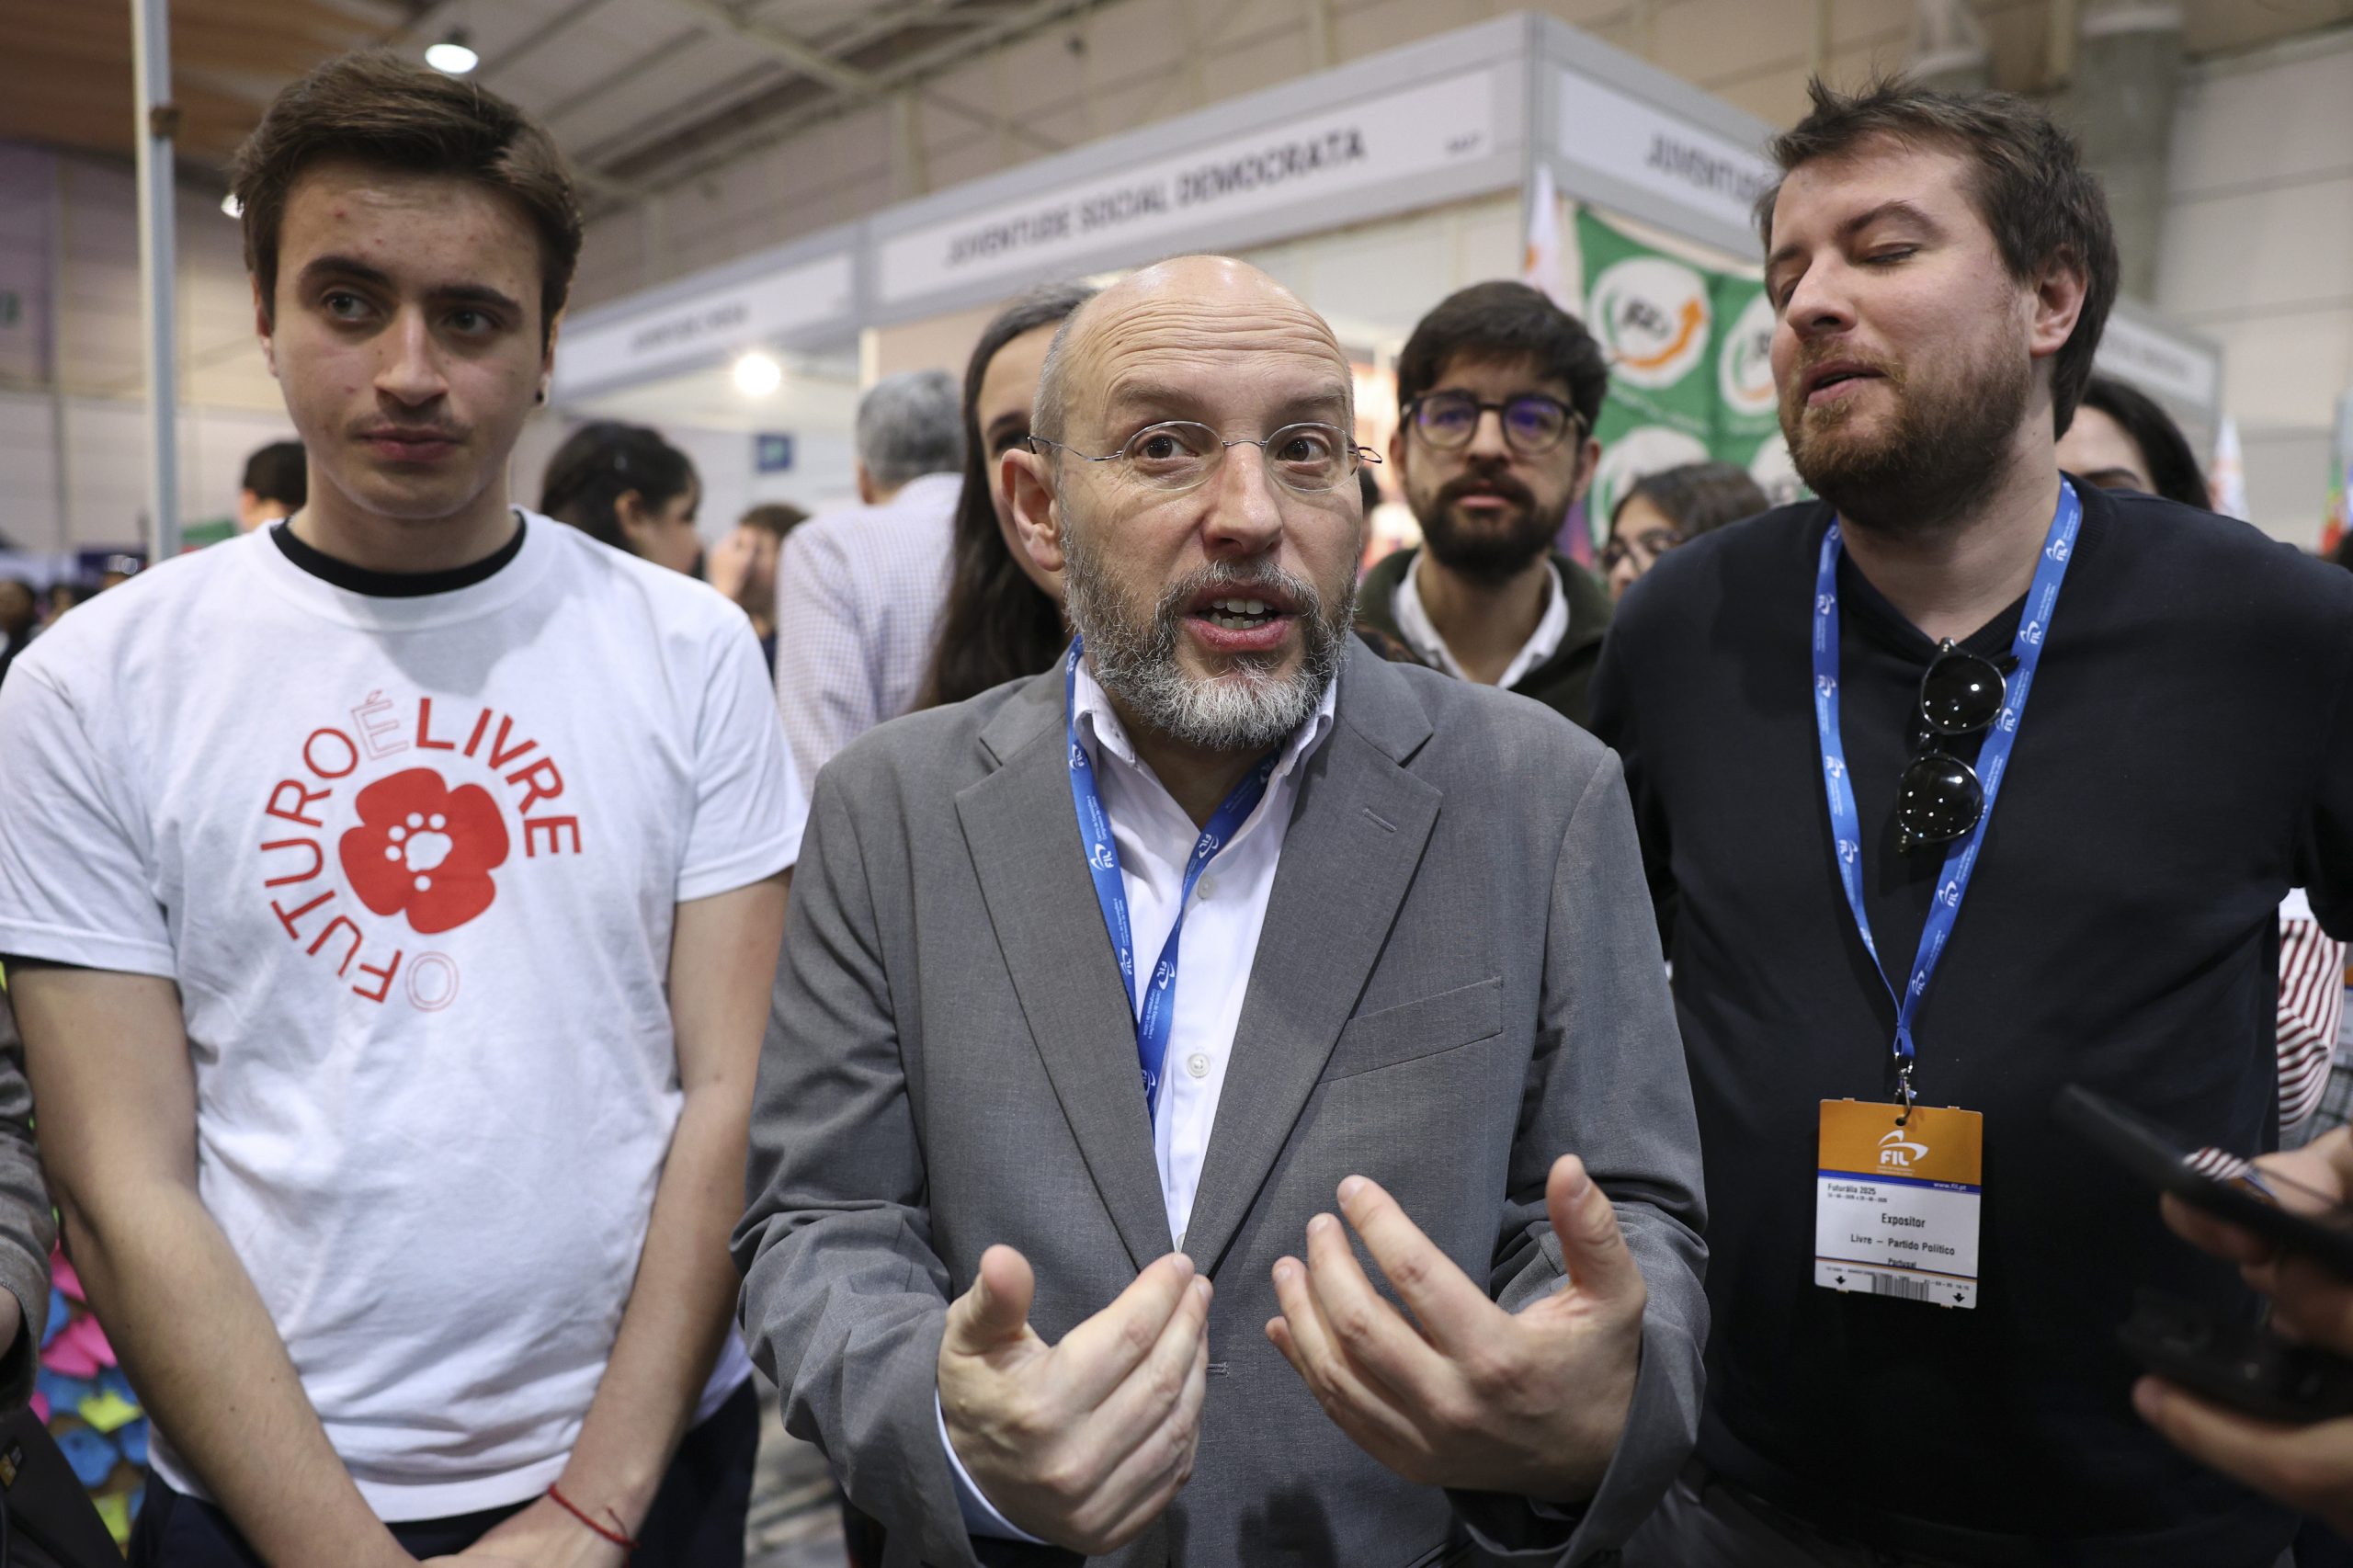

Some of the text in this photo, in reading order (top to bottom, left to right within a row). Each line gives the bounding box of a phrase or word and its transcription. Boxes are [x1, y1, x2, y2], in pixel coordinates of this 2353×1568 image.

[1079, 181, 1172, 233] SOCIAL
[1175, 127, 1368, 207] DEMOCRATA
[260, 728, 403, 1003] FUTURO
[351, 689, 409, 760] É
[415, 697, 582, 858] LIVRE
[1199, 834, 1211, 847] FIL
[1103, 851, 1114, 869] FIL
[1156, 960, 1166, 977] FIL
[1880, 1150, 1910, 1166] FIL
[1881, 1213, 1926, 1228] Expositor
[1850, 1233, 1872, 1244] Livre
[1888, 1238, 1919, 1251] Partido
